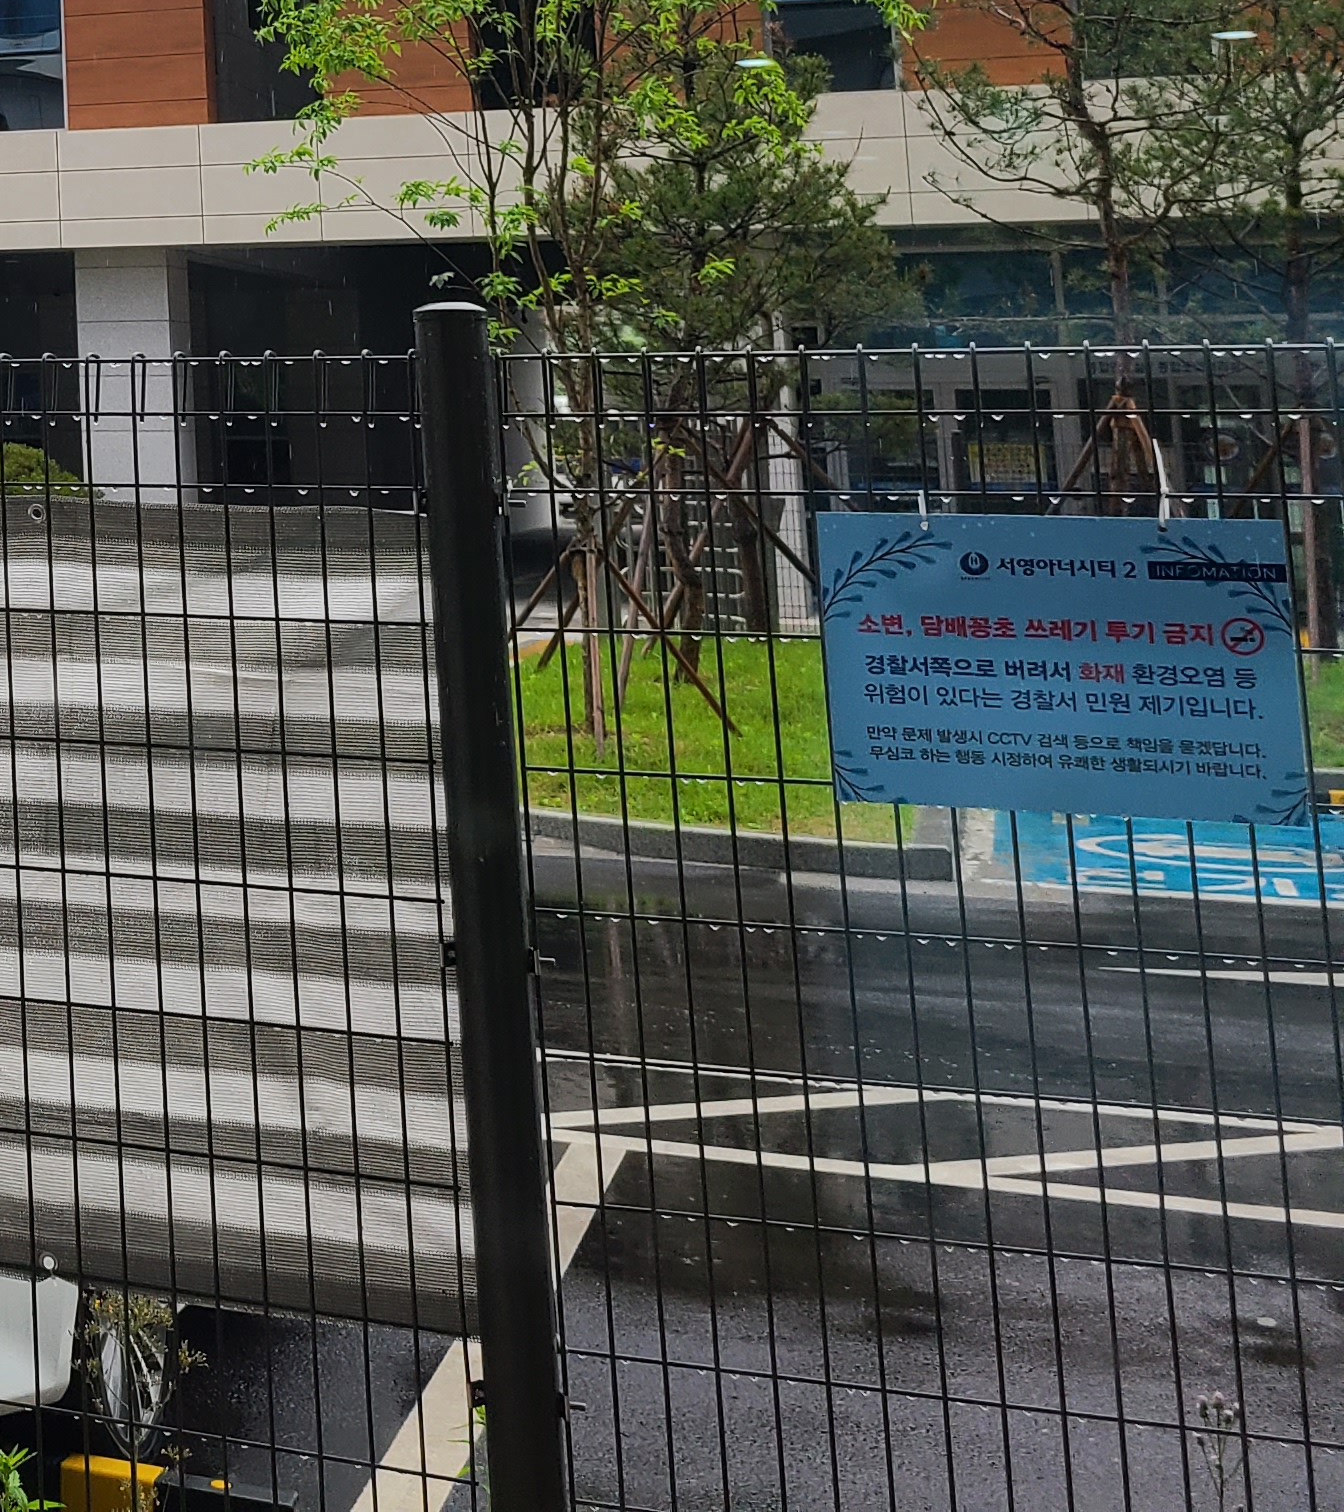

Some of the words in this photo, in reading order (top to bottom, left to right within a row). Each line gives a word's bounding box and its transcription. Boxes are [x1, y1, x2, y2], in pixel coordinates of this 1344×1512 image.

[996, 557, 1116, 578] 서영아너시티
[1123, 560, 1137, 579] 2
[857, 613, 912, 637] 소변,
[920, 615, 1016, 639] 담배꽁초
[1024, 618, 1098, 641] 쓰레기
[1105, 620, 1155, 644] 투기
[1163, 622, 1214, 646] 금지
[865, 654, 998, 677] 경찰서쪽으로
[1004, 659, 1072, 682] 버려서
[1078, 661, 1125, 684] 화재
[1131, 663, 1226, 688] 환경오염
[1233, 668, 1258, 689] 등
[864, 683, 929, 706] 위험이
[936, 686, 1003, 709] 있다는
[1010, 689, 1078, 712] 경찰서
[1085, 691, 1131, 715] 민원
[1138, 694, 1264, 720] 제기입니다.
[867, 725, 898, 741] 만약
[901, 727, 932, 744] 문제
[936, 728, 984, 745] 발생시
[987, 732, 1033, 746] CCTV
[1073, 735, 1122, 751] 등으로
[1126, 737, 1174, 754] 책임을
[869, 745, 917, 762] 무심코
[920, 747, 951, 763] 하는
[955, 749, 986, 766] 행동
[991, 751, 1053, 769] 시정하여
[1057, 754, 1106, 772] 유쾌한
[1196, 761, 1268, 781] 바랍니다.
